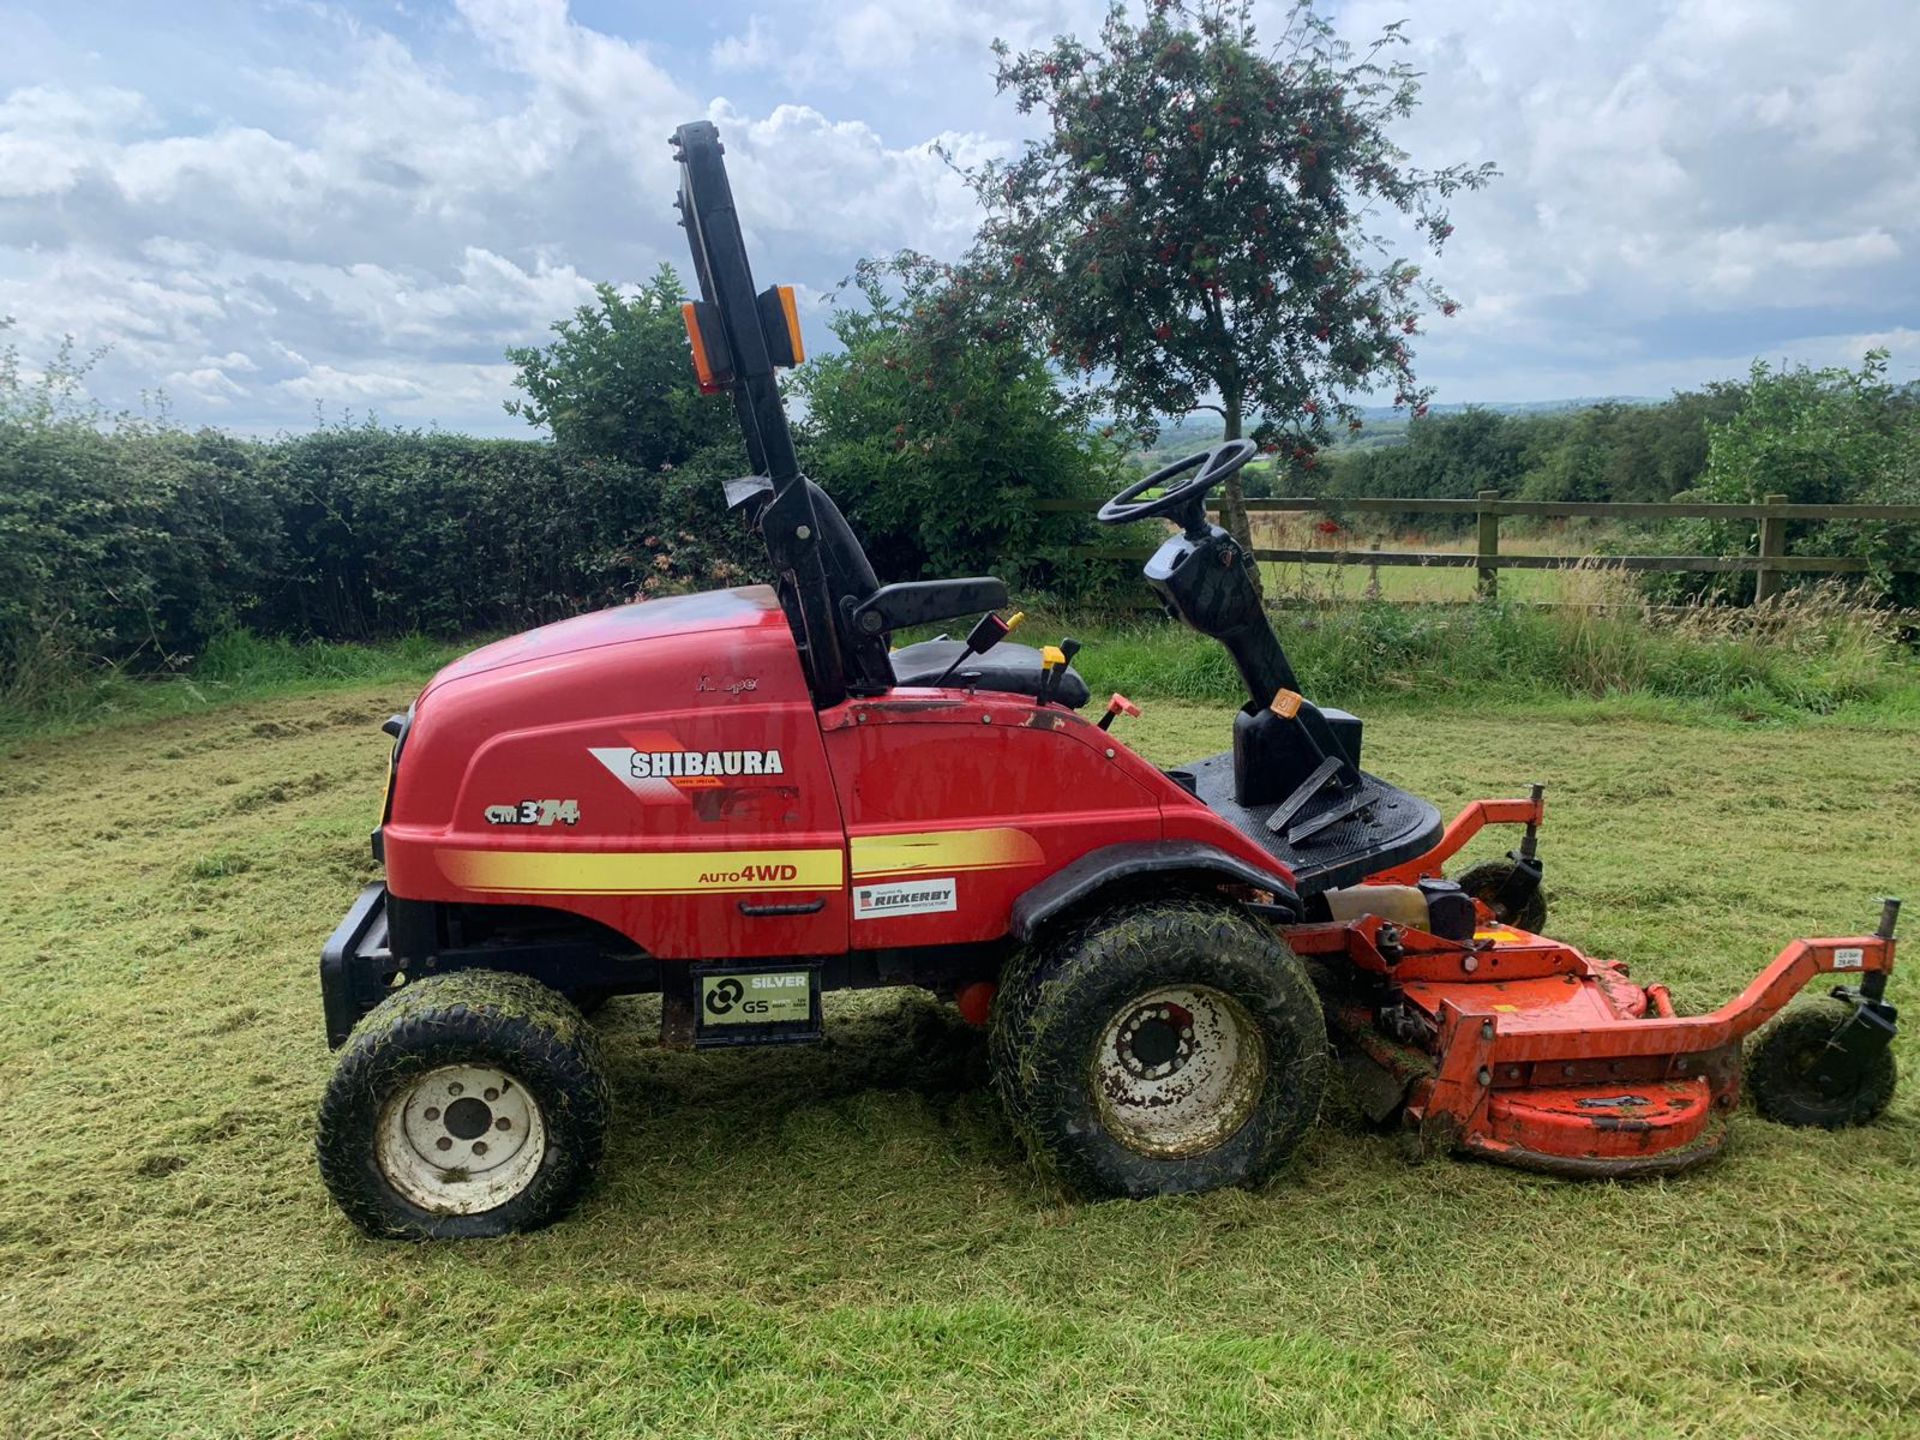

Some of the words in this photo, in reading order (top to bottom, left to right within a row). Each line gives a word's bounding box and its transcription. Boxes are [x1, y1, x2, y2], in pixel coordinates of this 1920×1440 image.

[631, 750, 784, 777] SHIBAURA
[874, 889, 951, 906] RICKERBY
[751, 976, 806, 989] SILVER
[742, 1000, 768, 1014] GS
